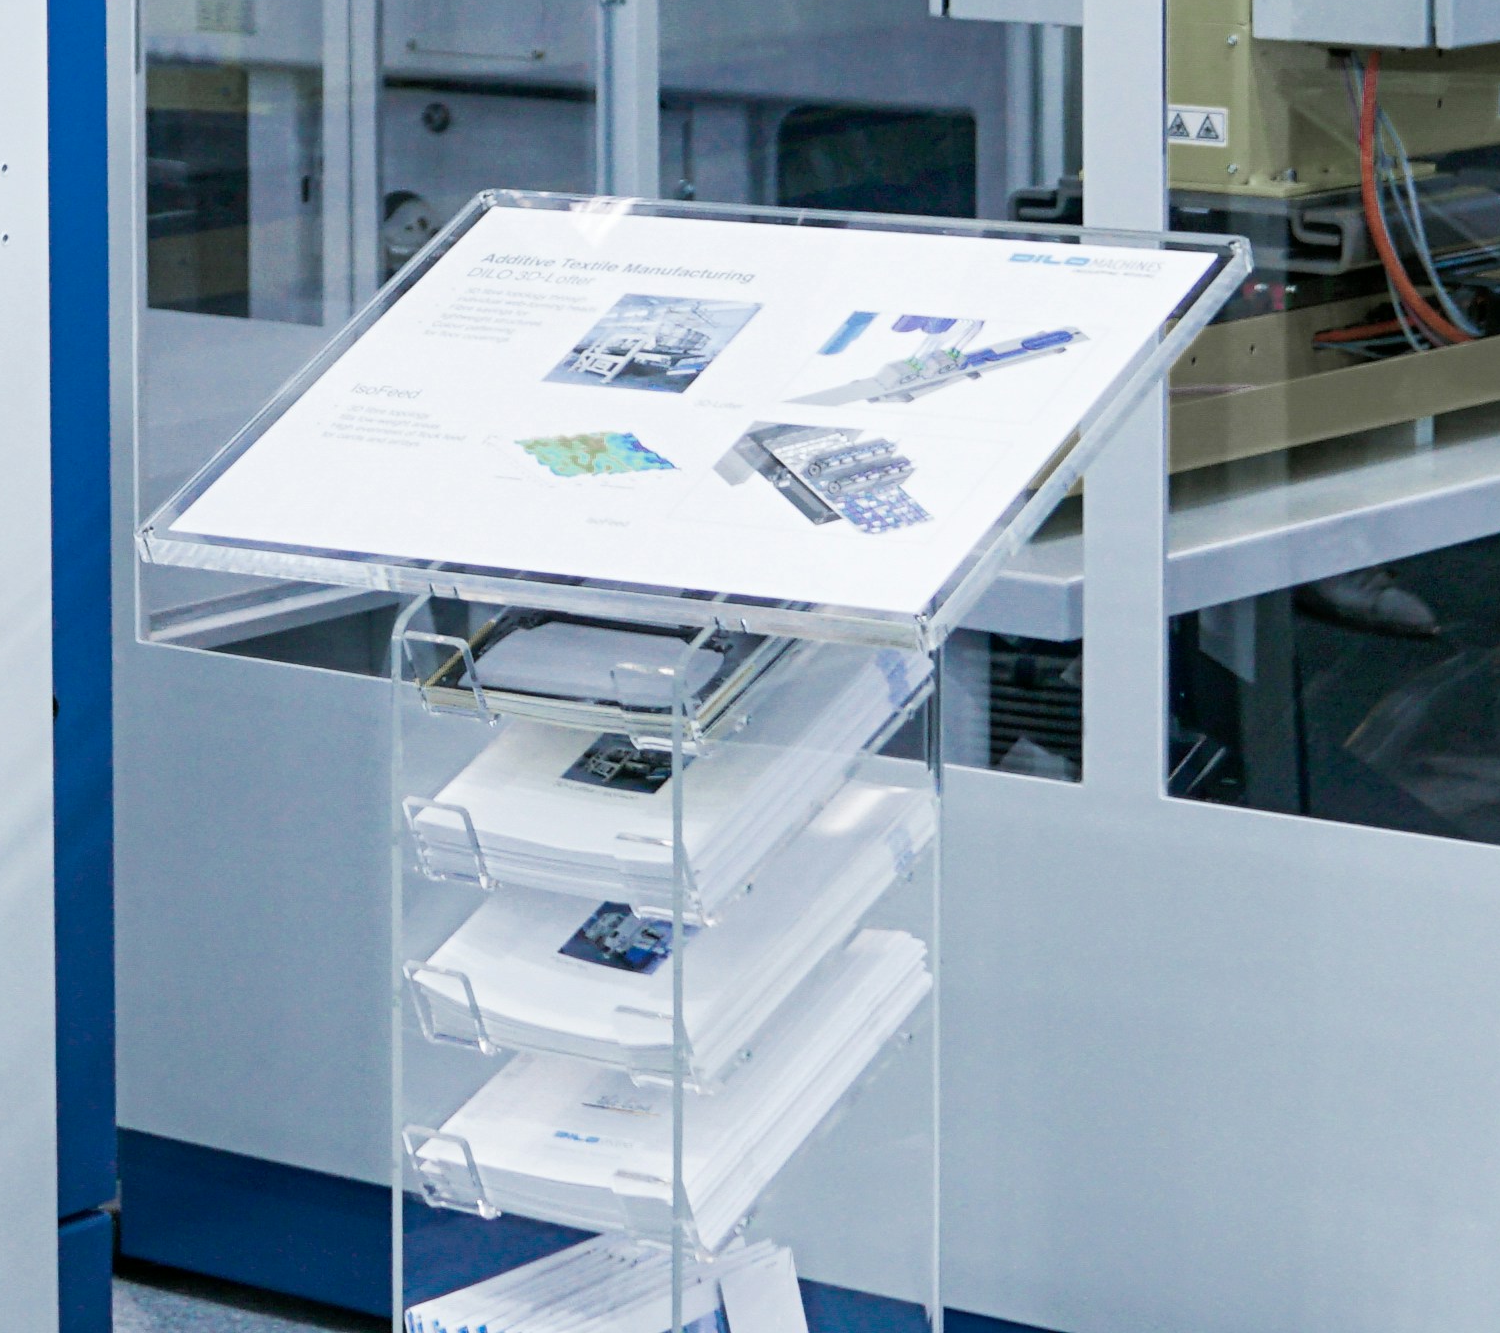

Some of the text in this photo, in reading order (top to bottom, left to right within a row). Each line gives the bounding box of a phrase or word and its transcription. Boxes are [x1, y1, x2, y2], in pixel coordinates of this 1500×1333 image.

[482, 252, 756, 284] Additive Textile Manufacturing
[1009, 253, 1166, 272] DILO MACHINES
[466, 267, 596, 286] DILO 3D-Lofter
[351, 383, 423, 399] IsoFeed
